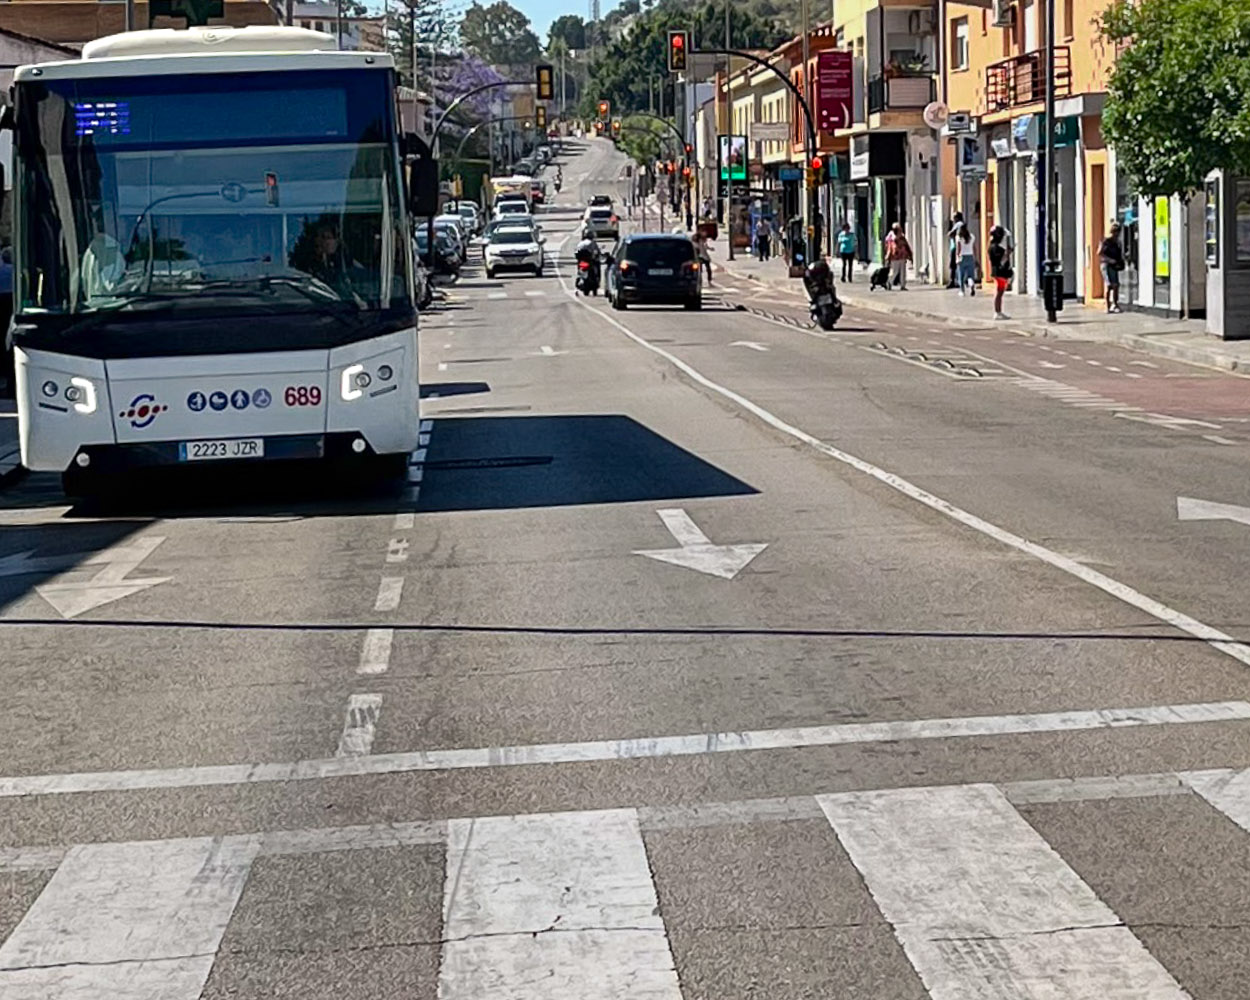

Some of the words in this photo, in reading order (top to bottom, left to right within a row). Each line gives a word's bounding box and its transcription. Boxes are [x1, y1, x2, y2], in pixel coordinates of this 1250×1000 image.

[284, 386, 322, 406] 689
[193, 442, 228, 457] 2223
[232, 441, 258, 456] JZR
